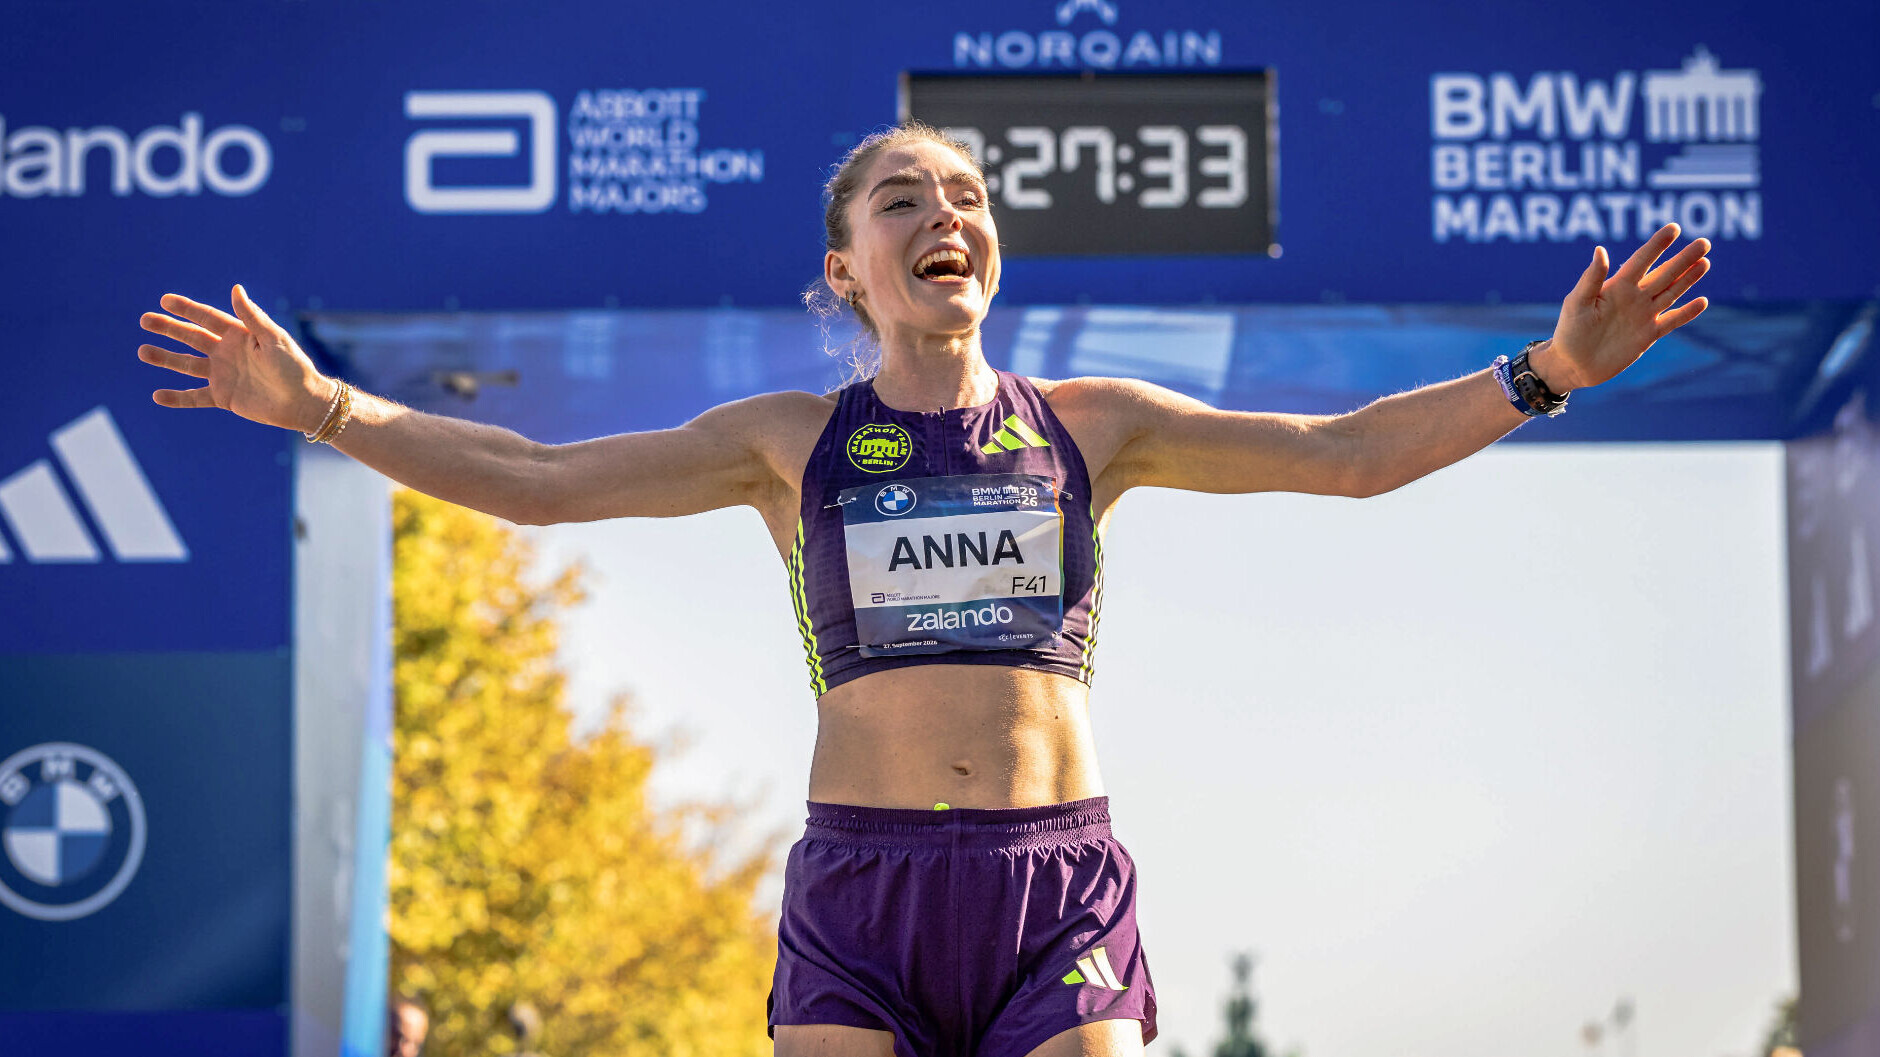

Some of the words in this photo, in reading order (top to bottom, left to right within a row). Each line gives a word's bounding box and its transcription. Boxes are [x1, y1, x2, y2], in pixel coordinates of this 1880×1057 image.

[953, 30, 1222, 68] NORQAIN
[571, 88, 707, 119] ABBOTT
[1432, 71, 1637, 141] BMW
[570, 121, 699, 149] WORLD
[0, 112, 273, 198] ando
[570, 149, 765, 183] MARATHON
[1432, 142, 1641, 190] BERLIN
[570, 180, 708, 214] MAJORS
[1432, 190, 1763, 242] MARATHON
[851, 428, 897, 453] MARATHON
[896, 432, 908, 456] TEAM
[862, 458, 894, 466] BERLIN
[880, 486, 910, 497] BMW
[972, 487, 1001, 496] BMW
[1019, 486, 1038, 496] 20
[1021, 496, 1038, 507] 26
[888, 529, 1024, 572] ANNA
[1011, 575, 1047, 595] F41
[906, 603, 1013, 632] zalando
[891, 641, 922, 649] September
